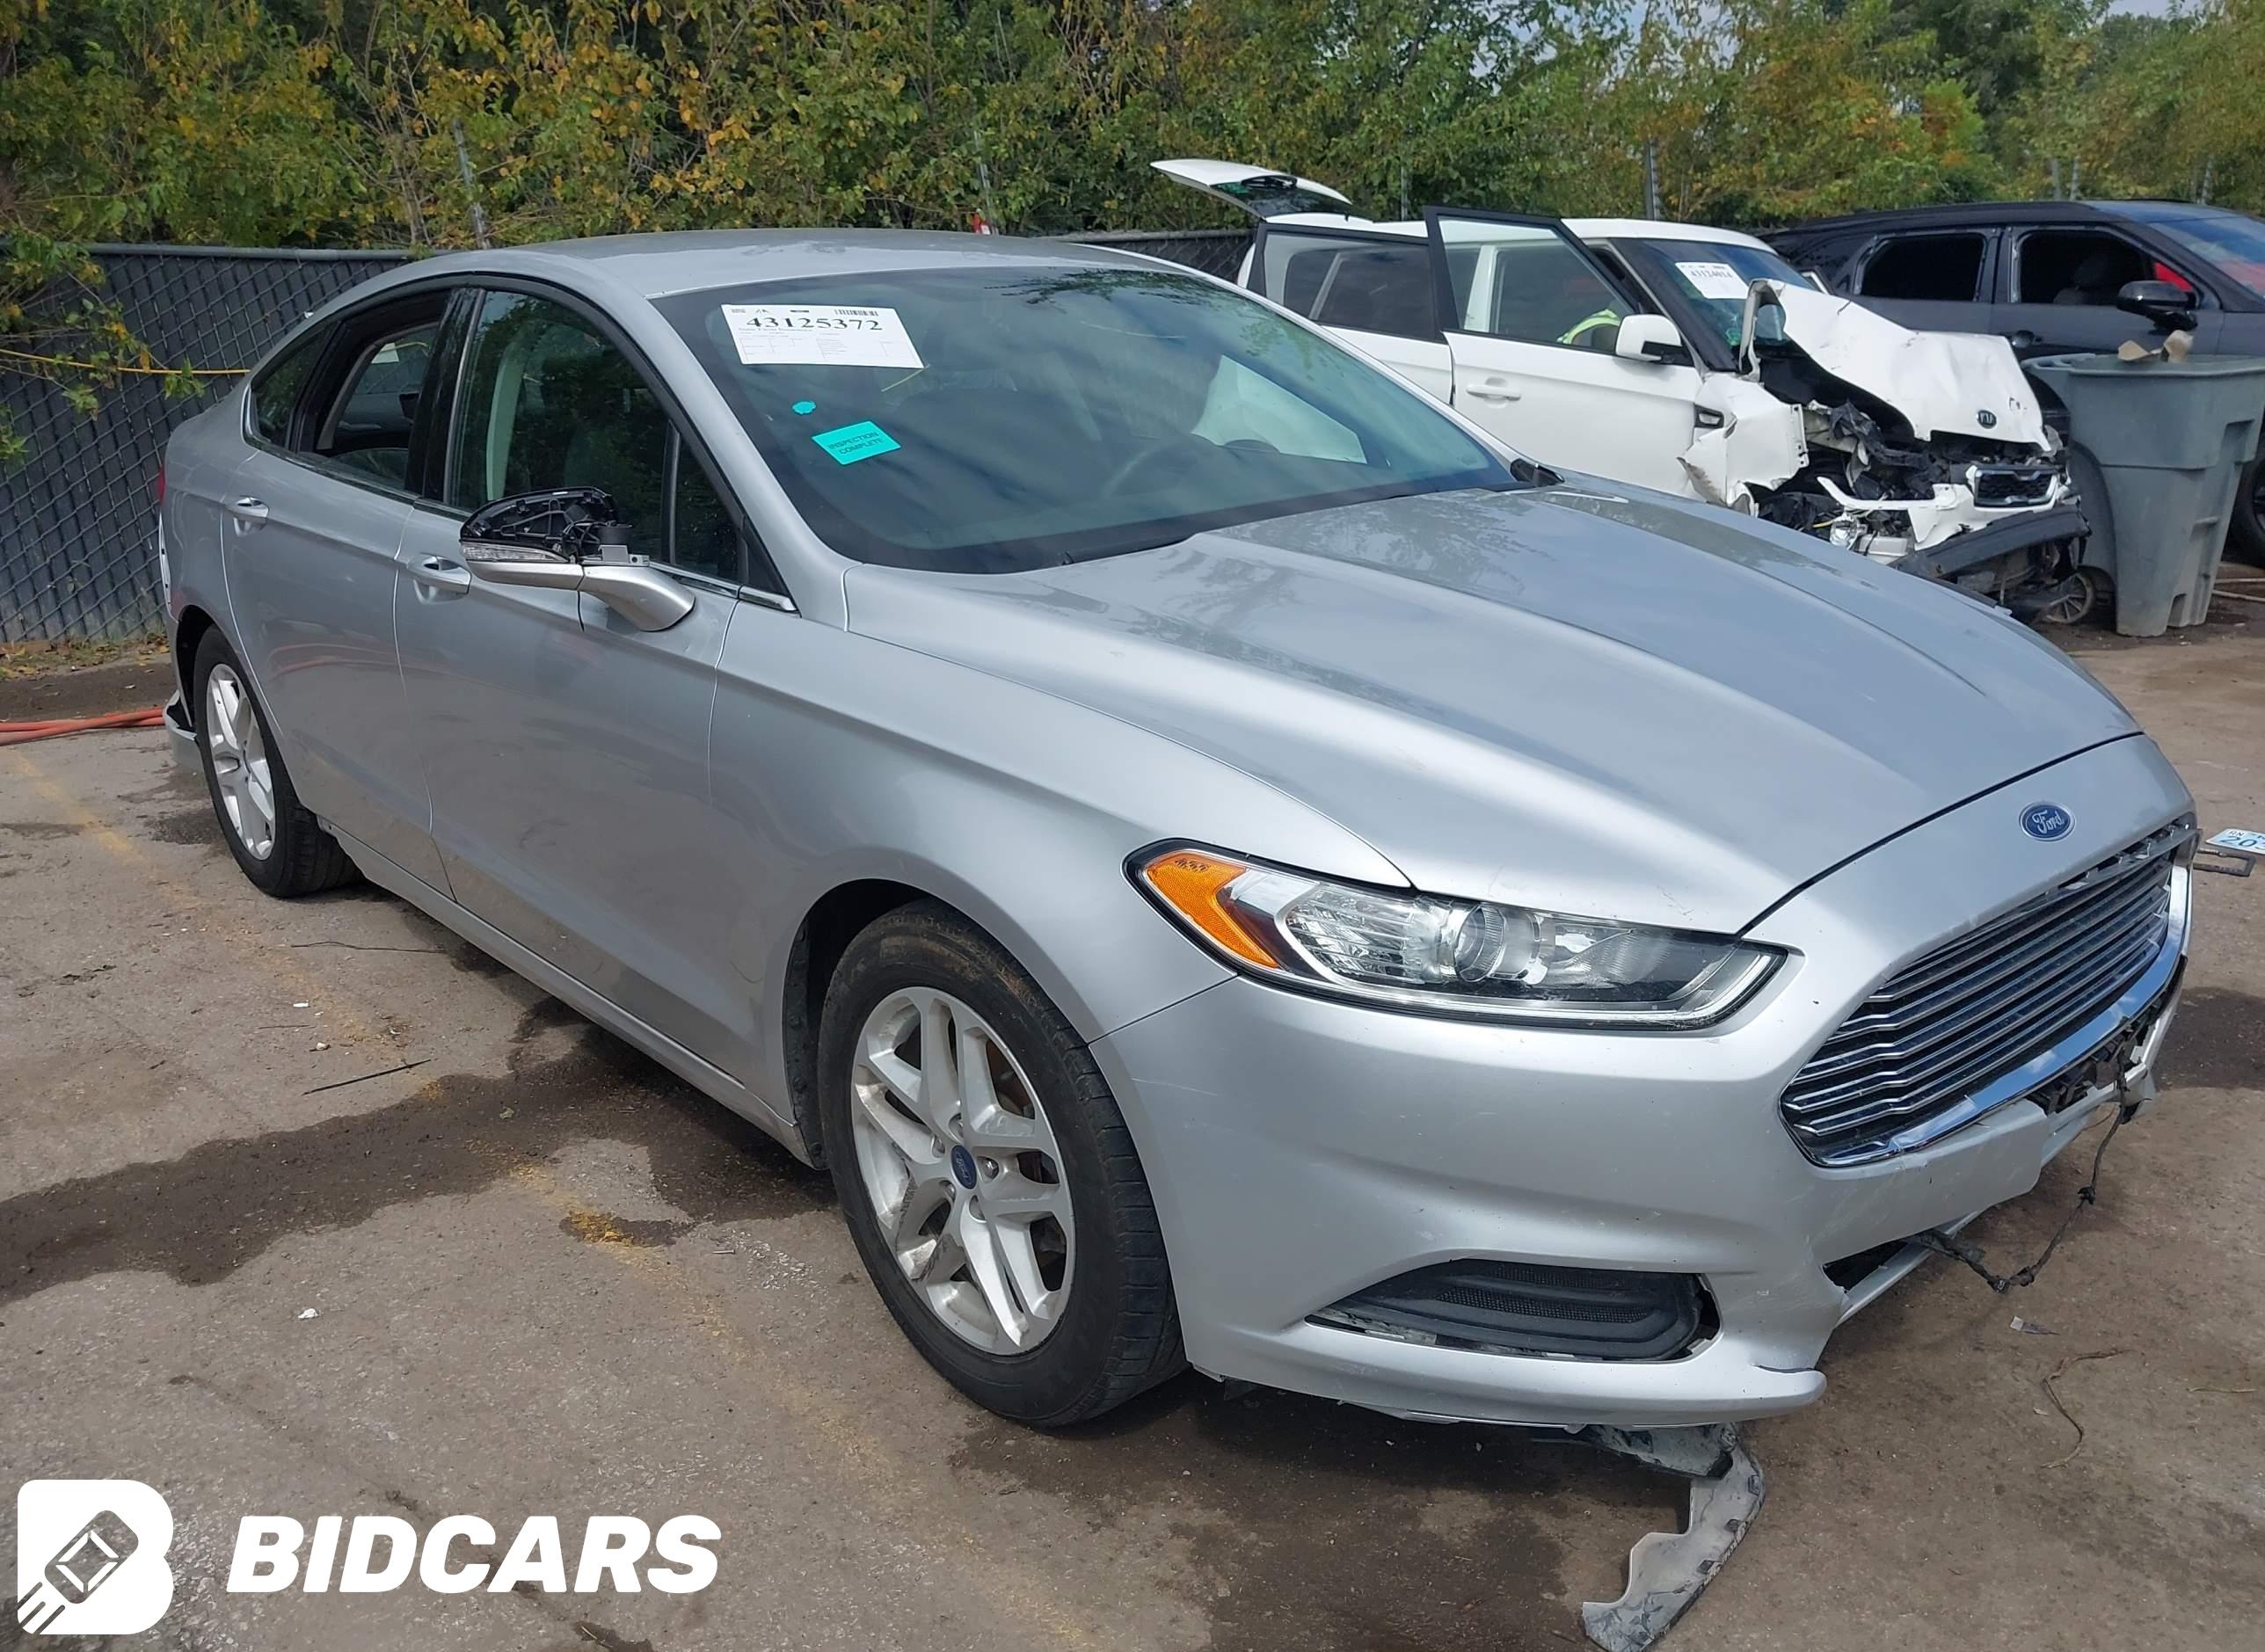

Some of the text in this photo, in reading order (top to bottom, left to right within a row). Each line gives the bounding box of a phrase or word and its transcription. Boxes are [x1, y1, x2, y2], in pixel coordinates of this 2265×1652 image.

[746, 317, 883, 331] 43125372
[827, 431, 879, 449] INSPECTION
[839, 438, 885, 455] COMPLETE
[2031, 809, 2065, 834] Ford
